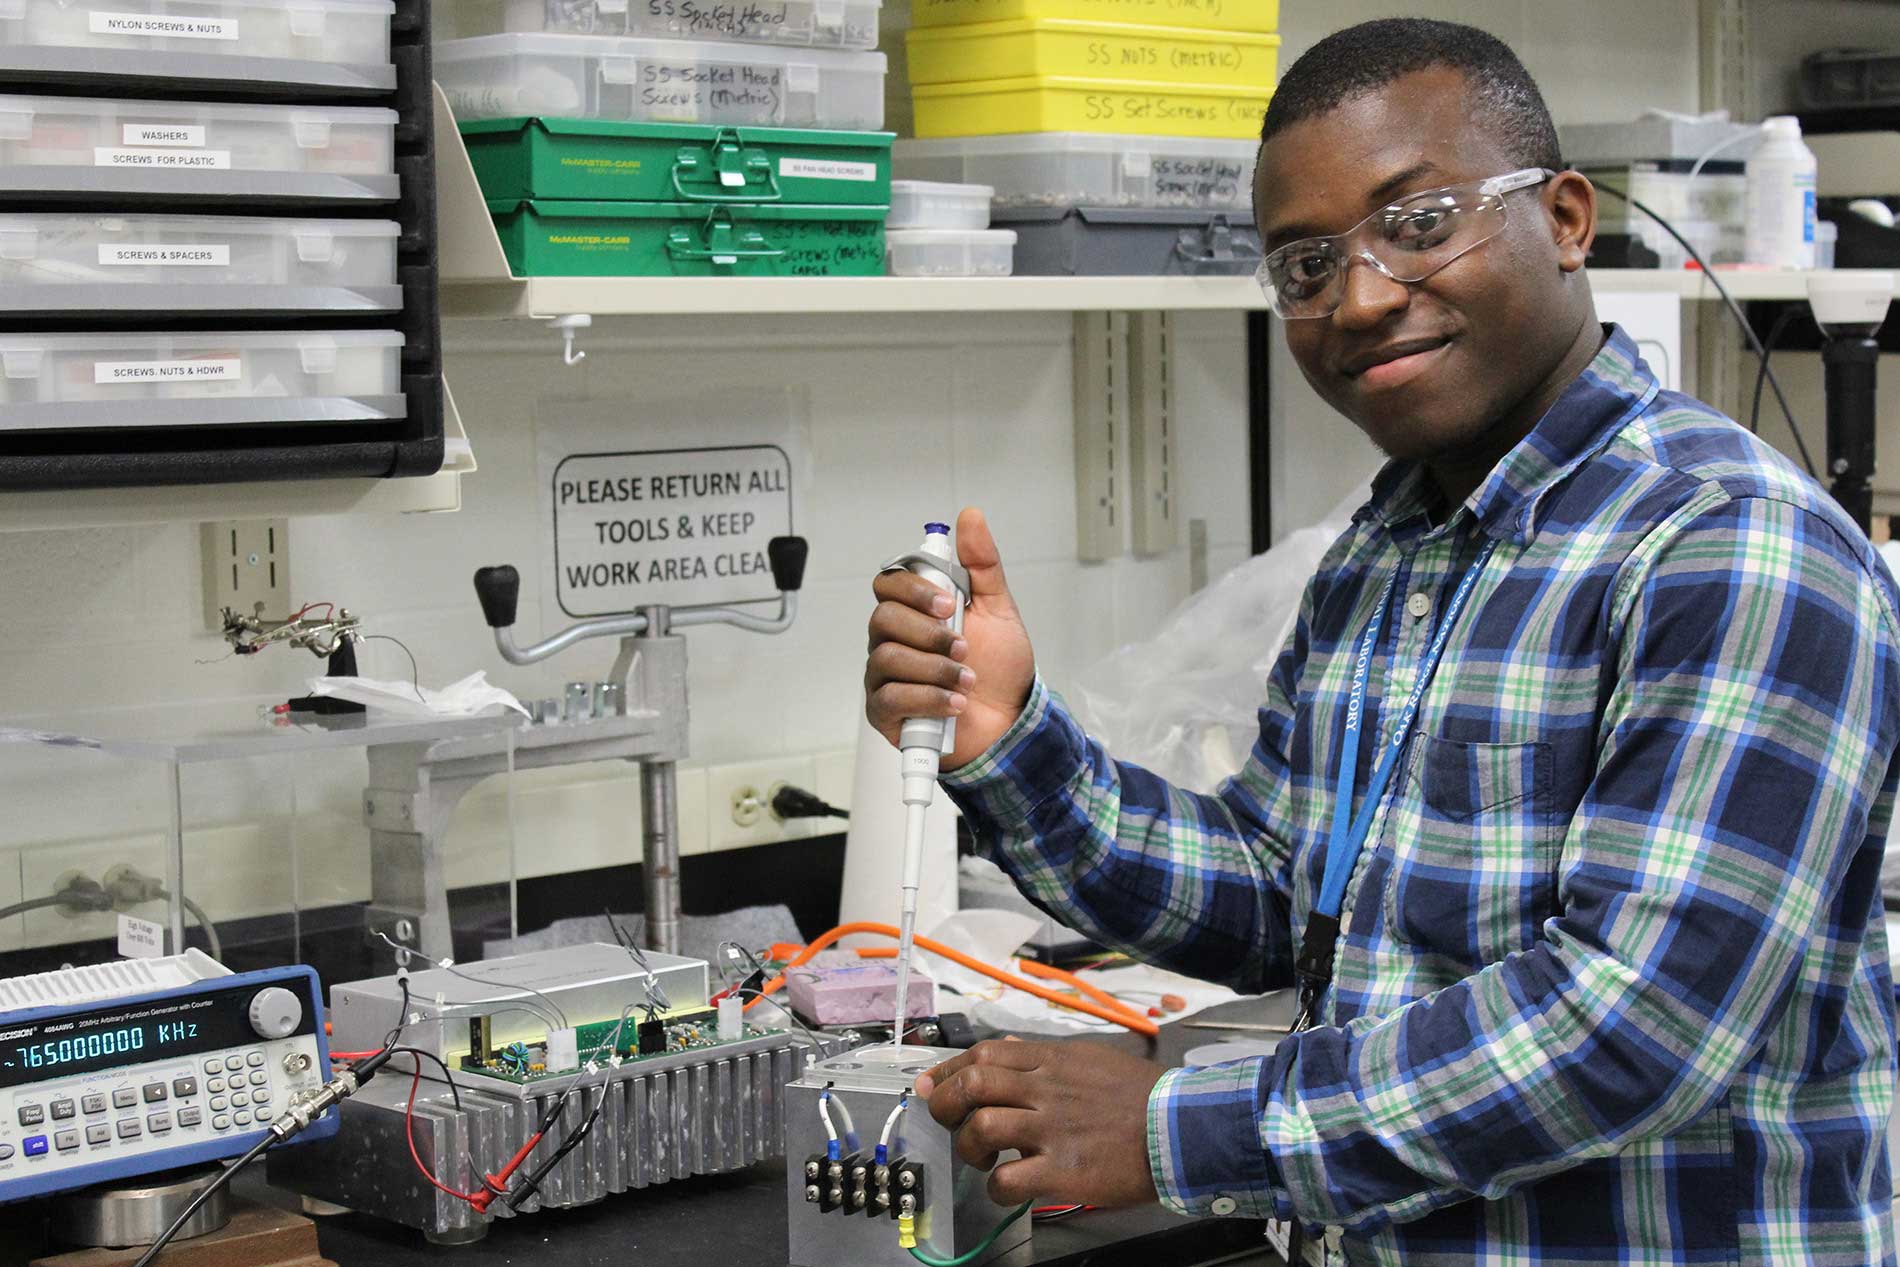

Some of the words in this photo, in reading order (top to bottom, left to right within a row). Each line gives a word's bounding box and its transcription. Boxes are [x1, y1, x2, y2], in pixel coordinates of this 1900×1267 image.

[740, 2, 787, 24] Head
[108, 19, 142, 29] NYLON
[145, 22, 185, 32] SCREWS
[187, 24, 194, 32] &
[196, 25, 222, 33] NUTS
[1087, 43, 1111, 65] SS
[1121, 47, 1157, 65] NUTS
[643, 65, 671, 83] SS
[742, 66, 780, 85] Head
[1085, 95, 1114, 120] SS
[1123, 97, 1151, 118] Set
[141, 131, 188, 140] WASHERS
[113, 155, 152, 164] SCREWS
[157, 156, 176, 165] FOR
[178, 157, 215, 165] PLASTIC
[117, 251, 158, 260] SCREWS
[160, 251, 167, 260] &
[169, 251, 213, 260] SPACERS
[160, 367, 185, 376] NUTS
[187, 367, 194, 375] &
[196, 366, 225, 375] HDWR
[561, 477, 643, 505] PLEASE
[650, 471, 741, 500] RETURN
[747, 469, 785, 494] ALL
[595, 516, 669, 544] TOOLS
[677, 515, 694, 539] &
[702, 512, 755, 538] KEEP
[567, 560, 641, 588] WORK
[647, 557, 708, 583] AREA
[714, 551, 772, 578] CLEA
[1393, 711, 1414, 746] OAK
[1408, 658, 1435, 708] RIDGE
[1431, 572, 1476, 655] NATIONAL
[1345, 625, 1378, 731] LABORATORY
[151, 1005, 178, 1016] Generator
[191, 1000, 214, 1009] Counter
[158, 1020, 198, 1044] KHz
